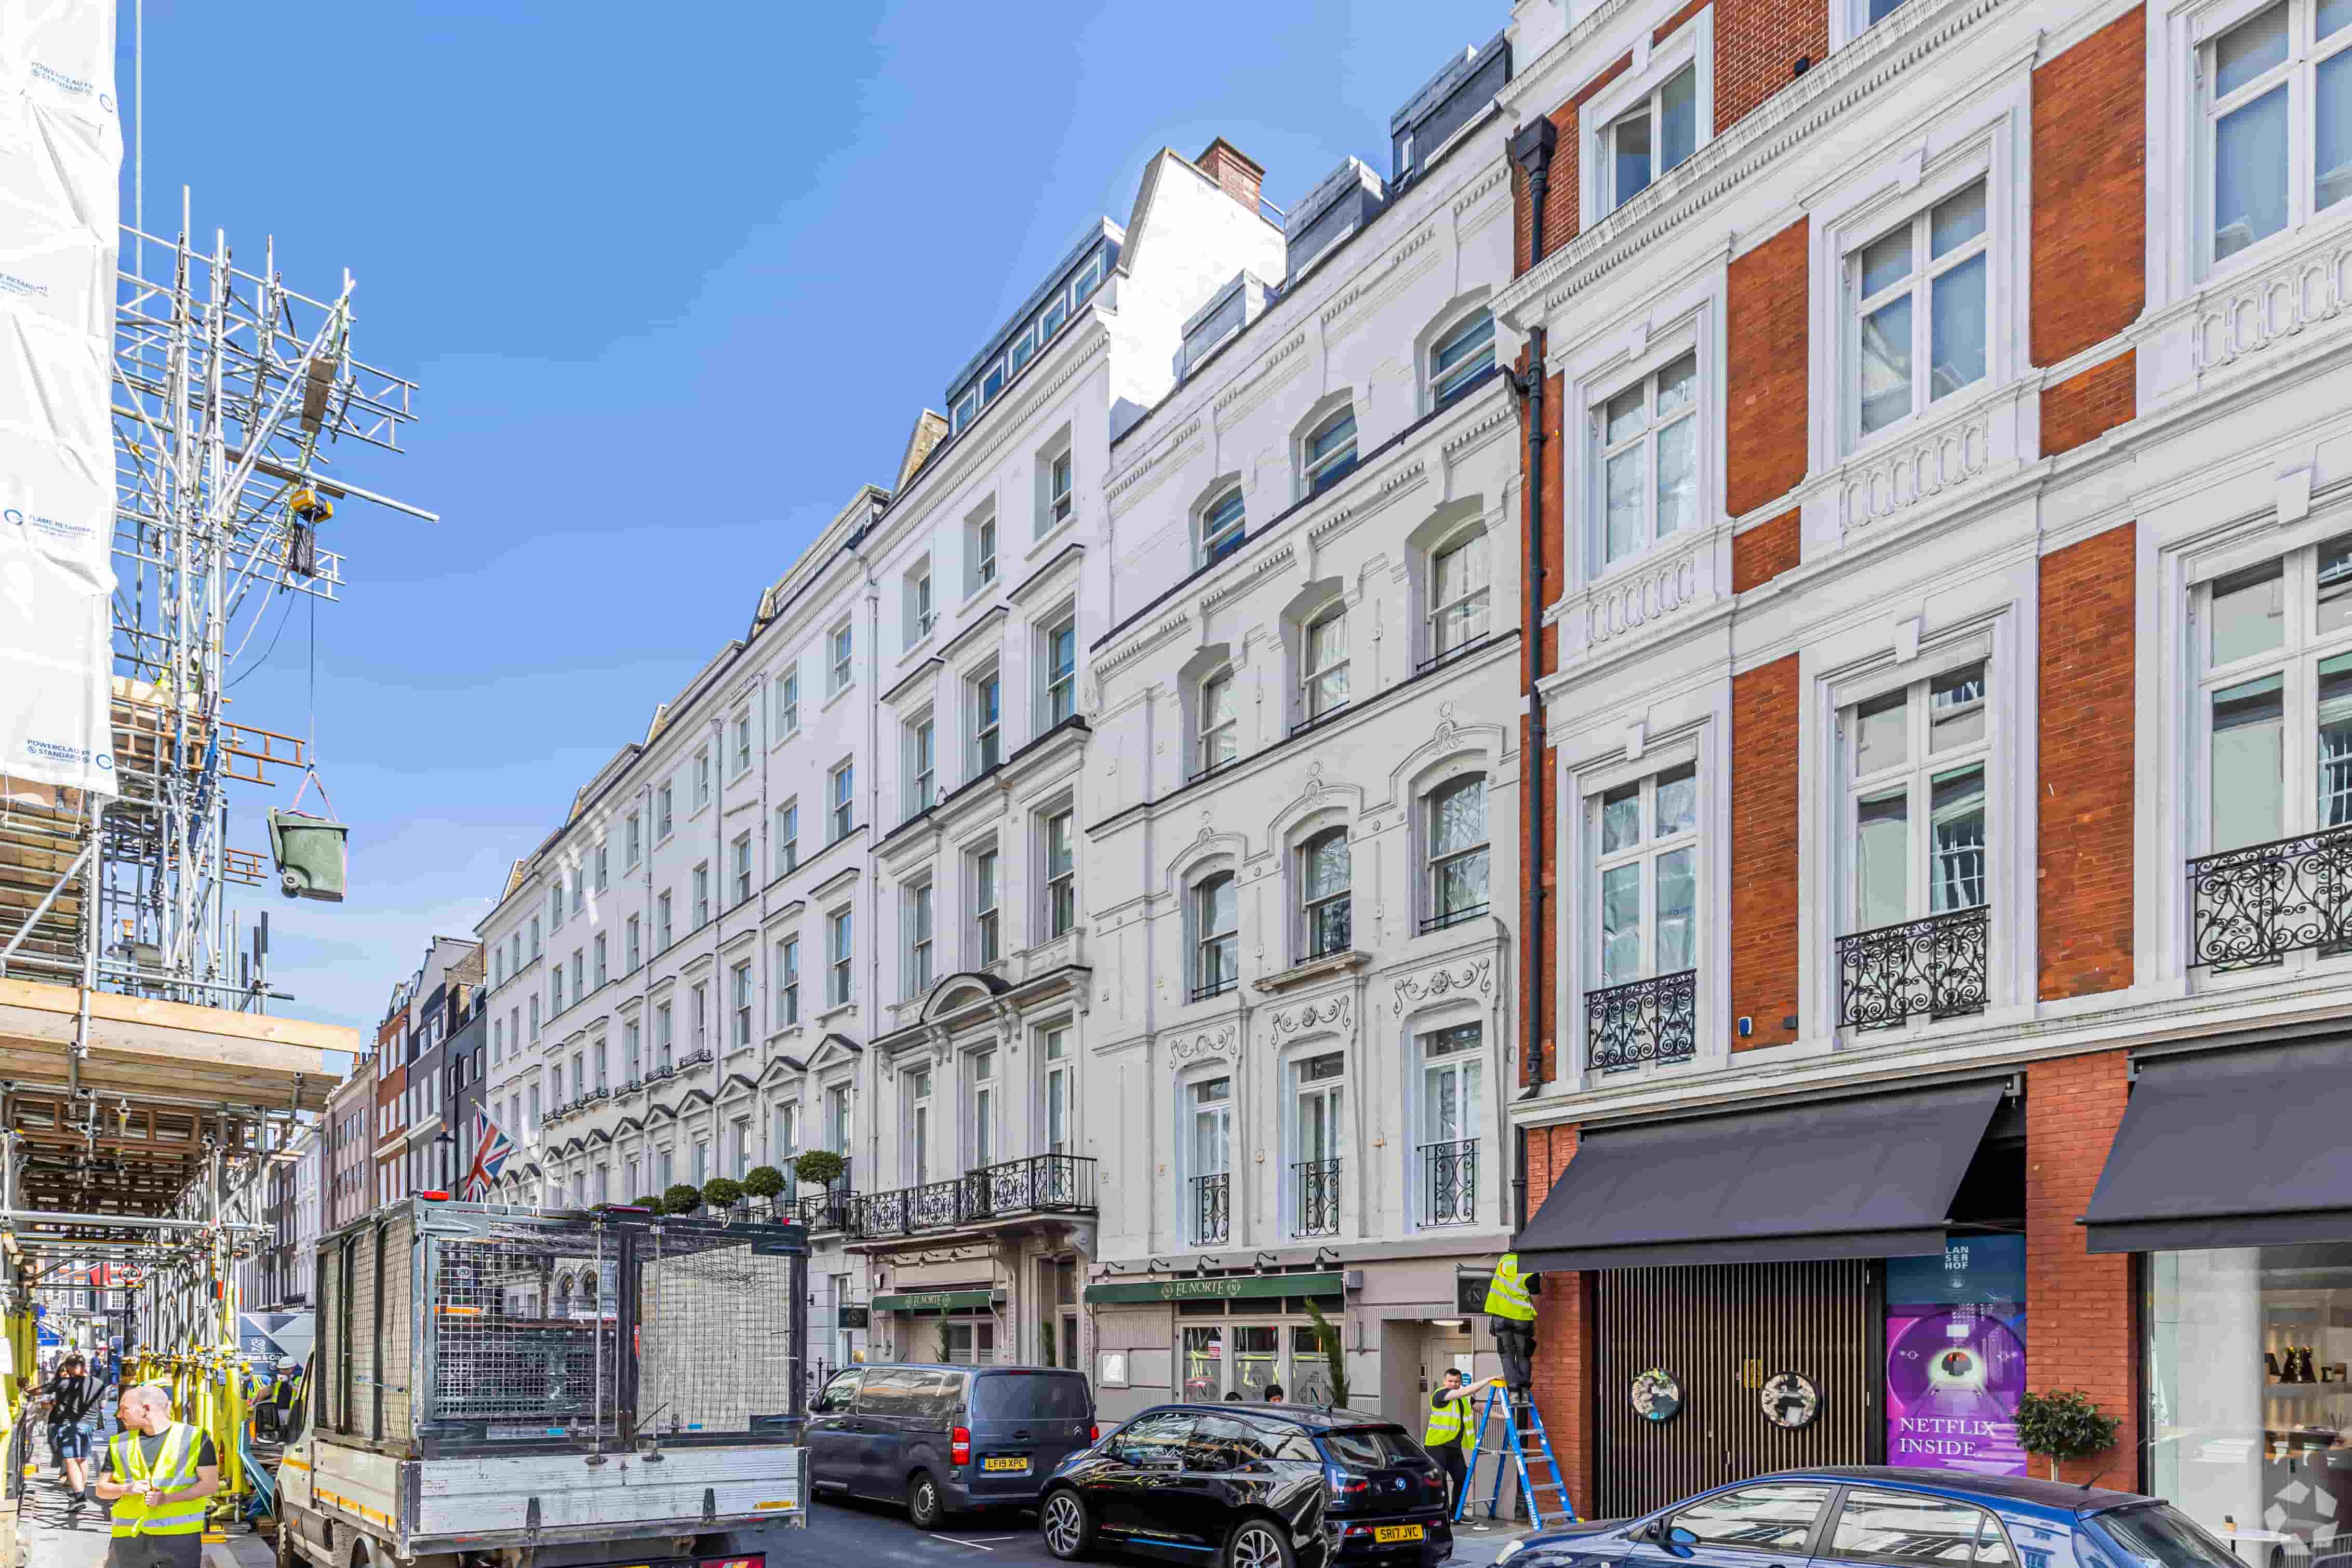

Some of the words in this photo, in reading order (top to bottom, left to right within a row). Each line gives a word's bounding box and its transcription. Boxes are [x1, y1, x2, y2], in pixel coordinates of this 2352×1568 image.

[28, 740, 79, 754] POWERCLAD
[38, 748, 81, 761] STANDARD
[1945, 1246, 1969, 1254] LAN
[1945, 1254, 1969, 1262] SER
[1945, 1262, 1970, 1270] HOF
[1176, 1282, 1188, 1296] EL
[1189, 1280, 1226, 1295] NORTE
[923, 1295, 940, 1305] NORTE
[1899, 1417, 1997, 1435] NETFLIX
[1899, 1438, 1982, 1456] INSIDE.
[988, 1459, 1006, 1468] LF19
[1008, 1459, 1024, 1467] XPC
[1380, 1528, 1400, 1540] SR17
[1402, 1526, 1419, 1538] JVC
